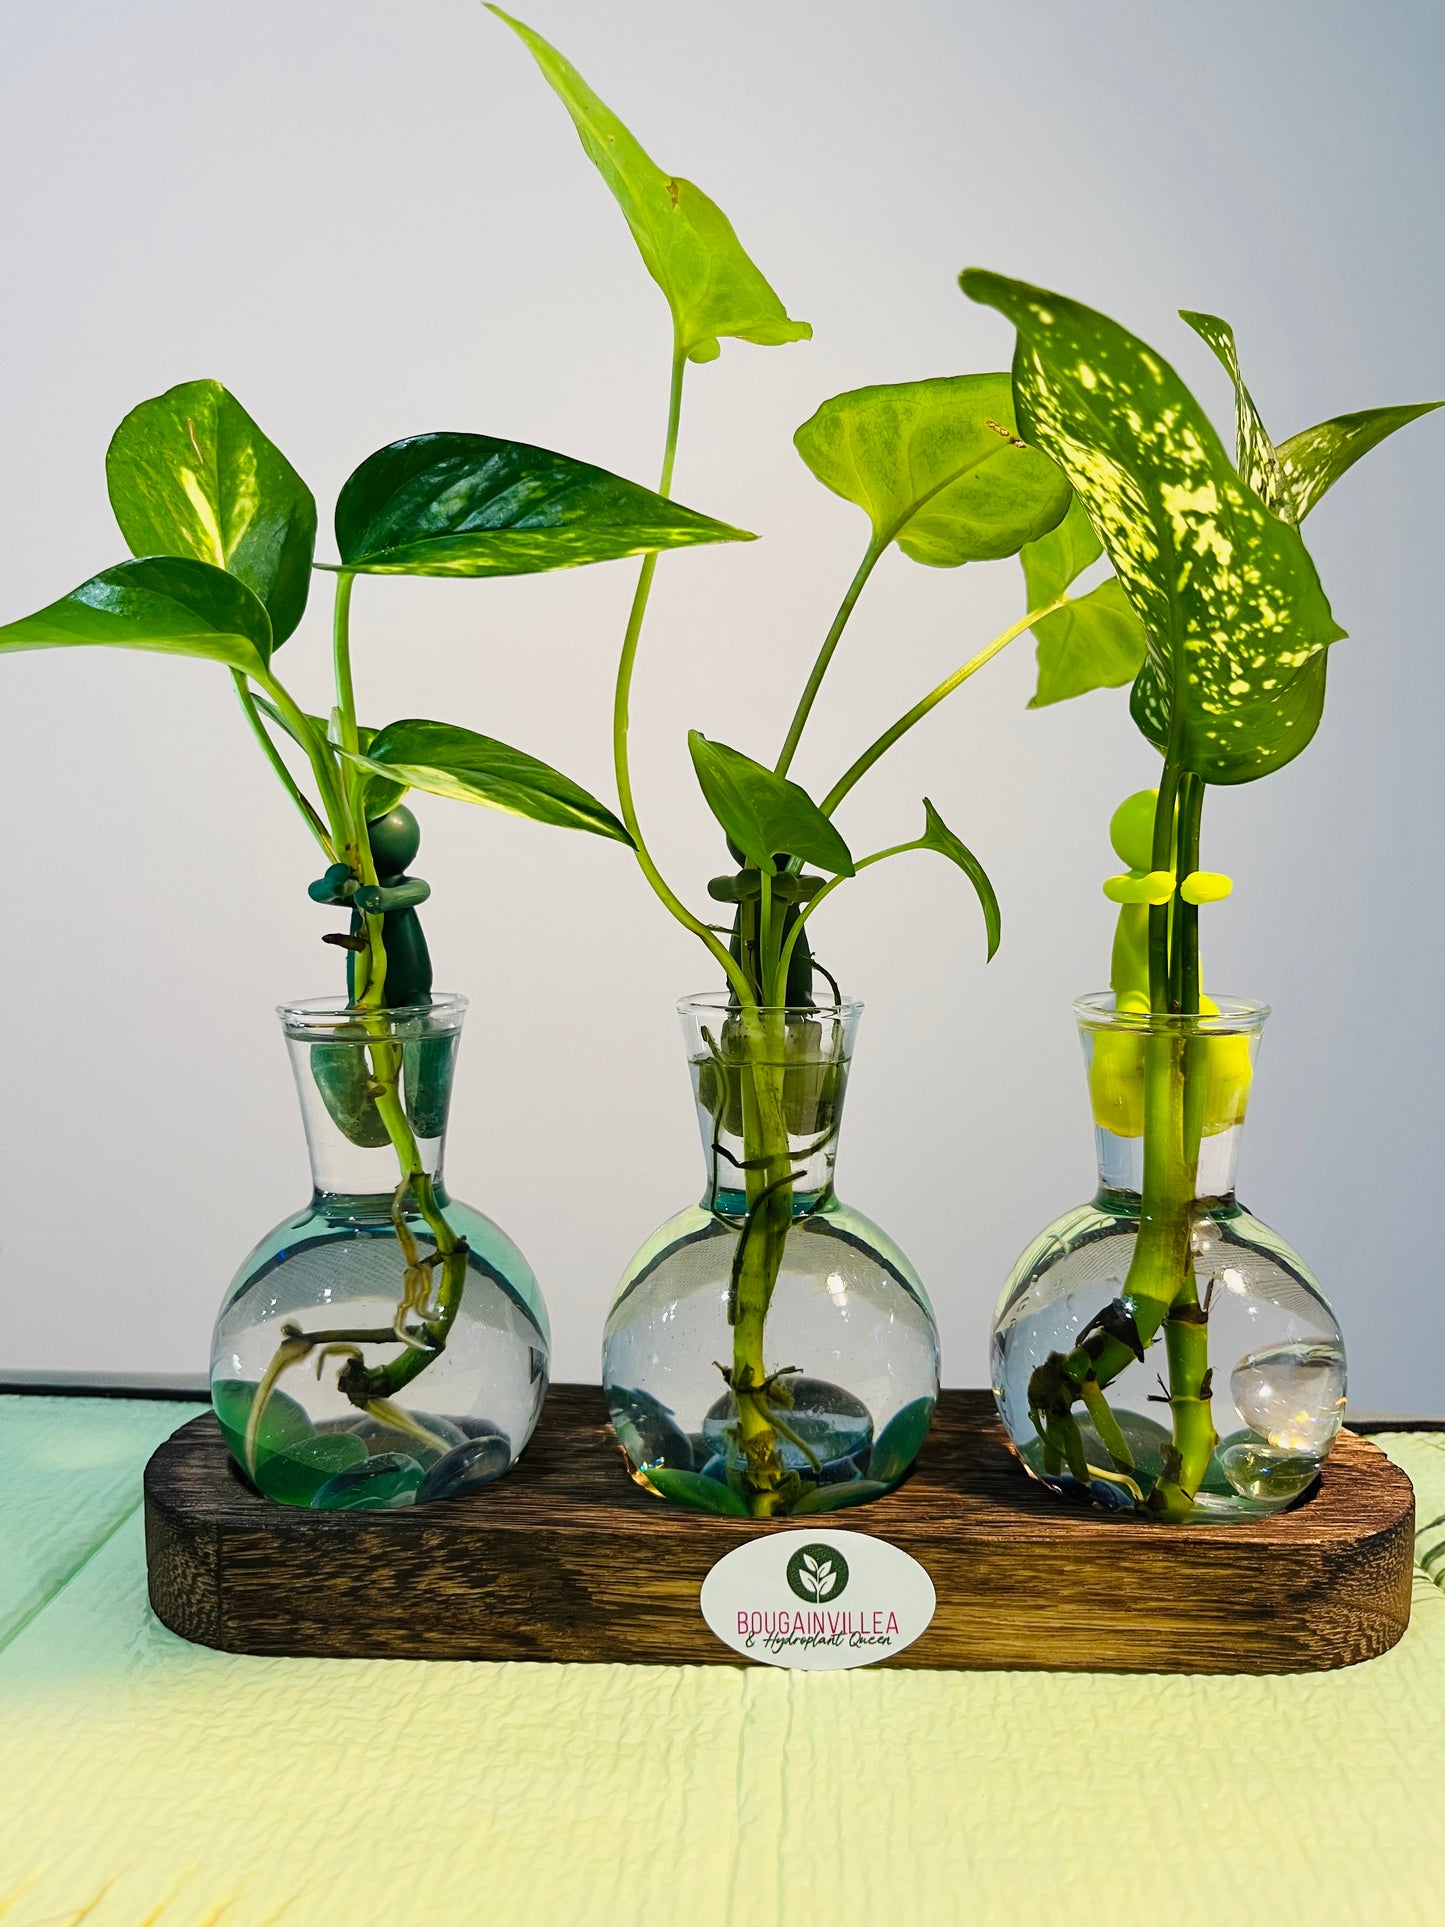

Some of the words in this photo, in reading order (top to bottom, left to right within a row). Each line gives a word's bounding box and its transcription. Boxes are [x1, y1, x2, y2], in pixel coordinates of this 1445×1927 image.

[737, 1611, 899, 1635] BOUGAINVILLEA
[745, 1630, 755, 1648] &
[763, 1630, 844, 1654] Hydroplant
[849, 1630, 892, 1648] Queen
